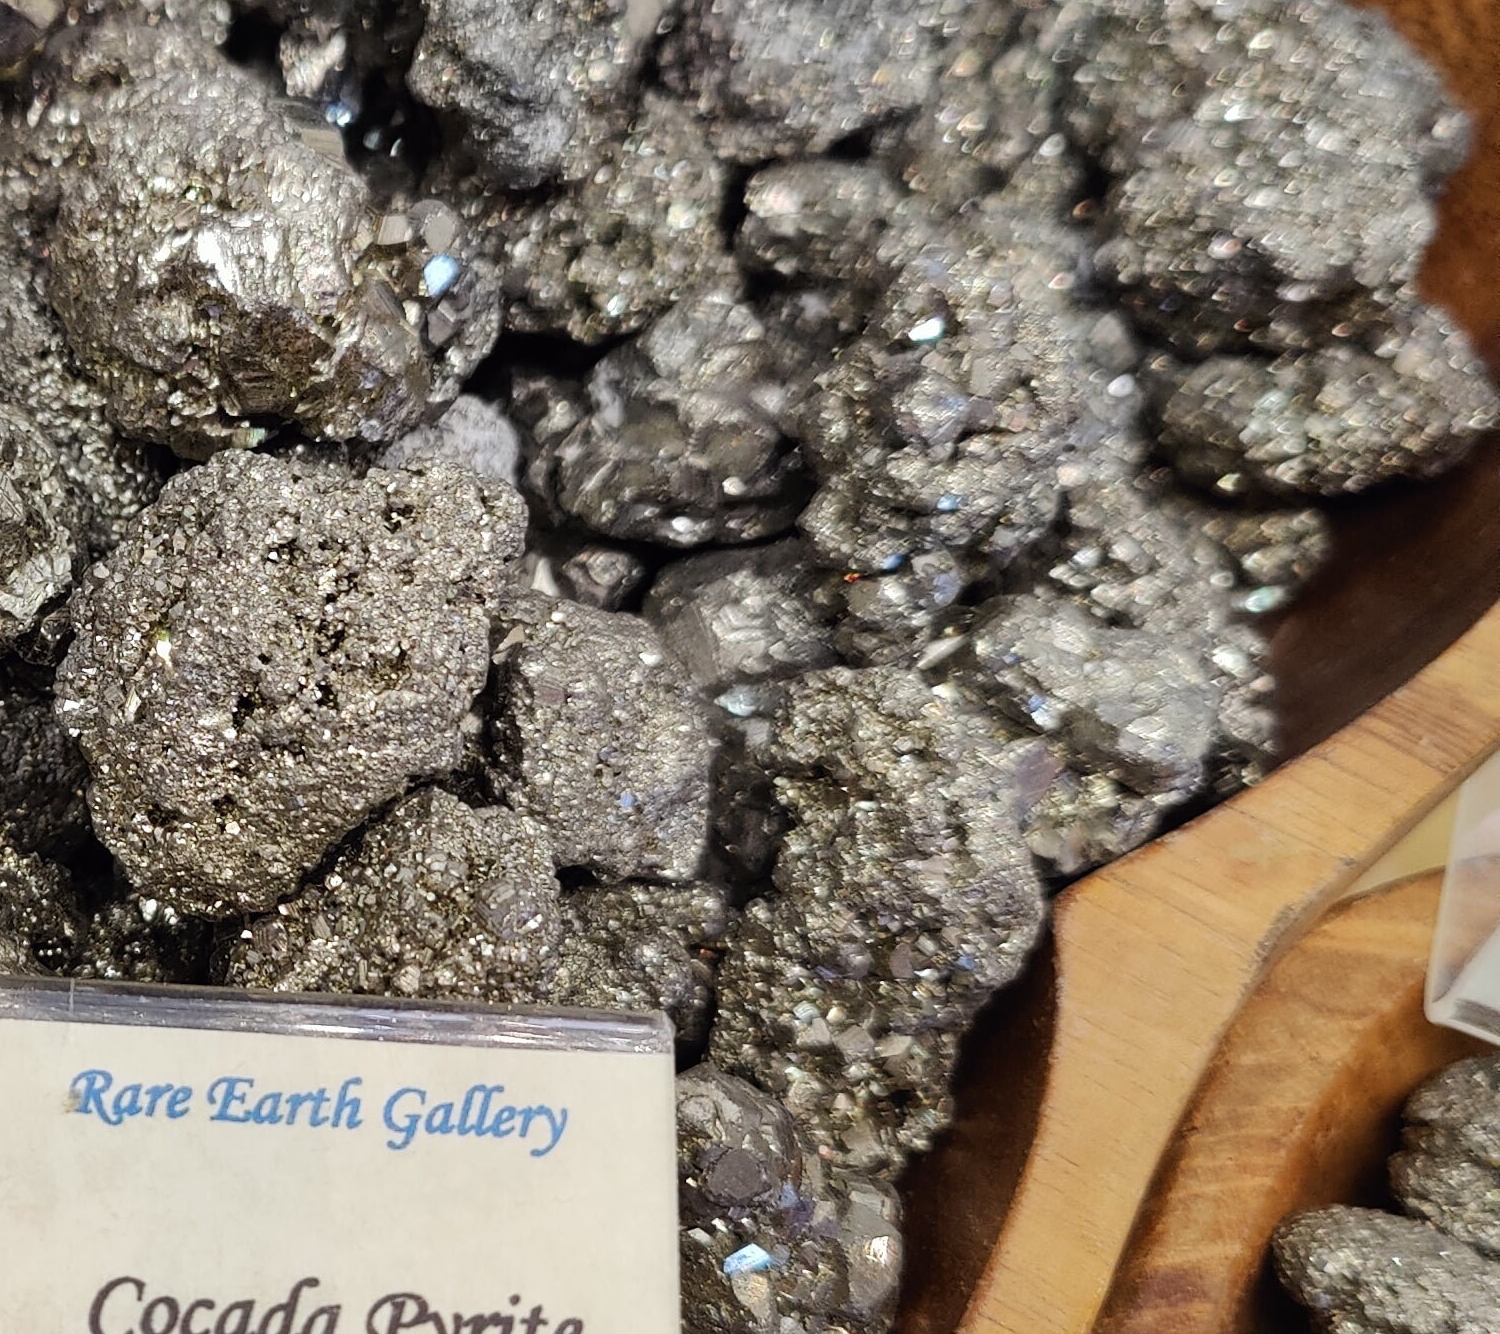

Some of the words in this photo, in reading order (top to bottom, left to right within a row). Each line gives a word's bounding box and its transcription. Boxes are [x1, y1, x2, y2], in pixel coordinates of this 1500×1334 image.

[71, 1069, 193, 1126] Rare
[207, 1077, 363, 1130] Earth
[383, 1084, 568, 1157] Gallery
